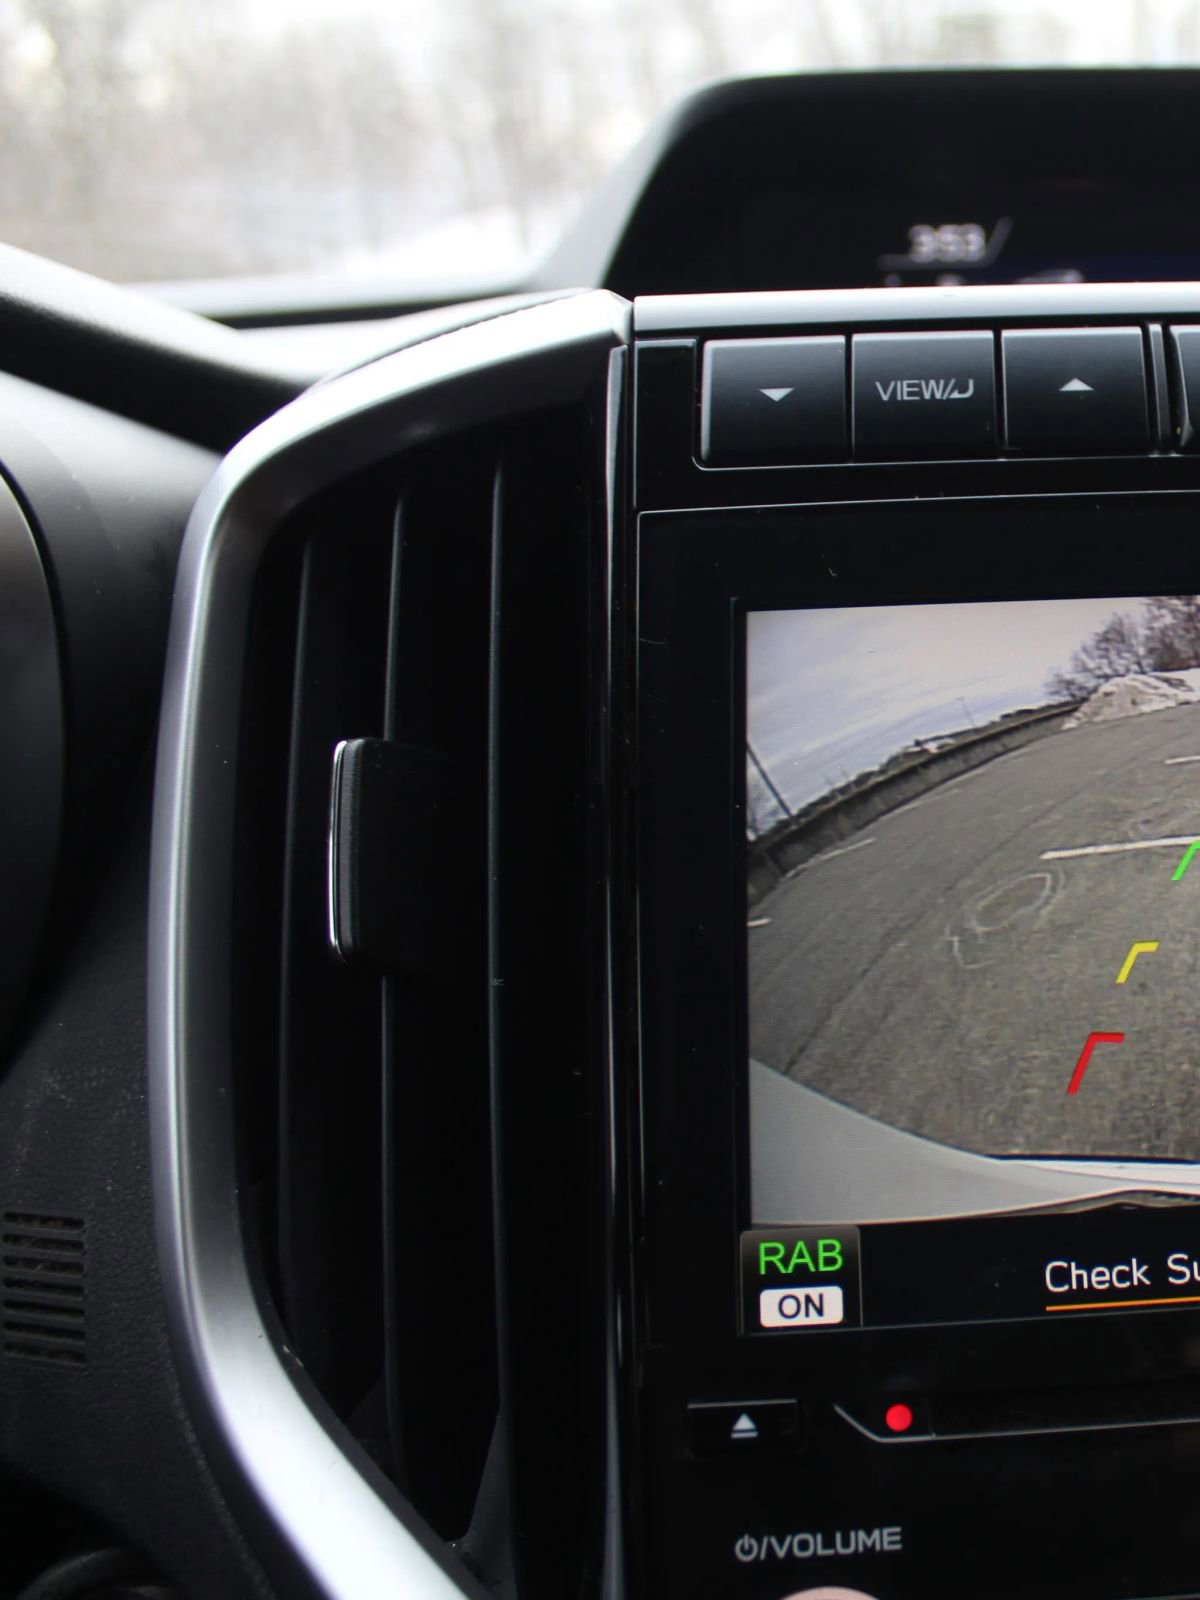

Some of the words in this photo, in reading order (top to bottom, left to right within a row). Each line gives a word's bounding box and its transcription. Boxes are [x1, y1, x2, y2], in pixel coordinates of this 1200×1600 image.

[759, 1238, 843, 1275] RAB
[1045, 1257, 1151, 1292] Check
[778, 1293, 824, 1319] ON
